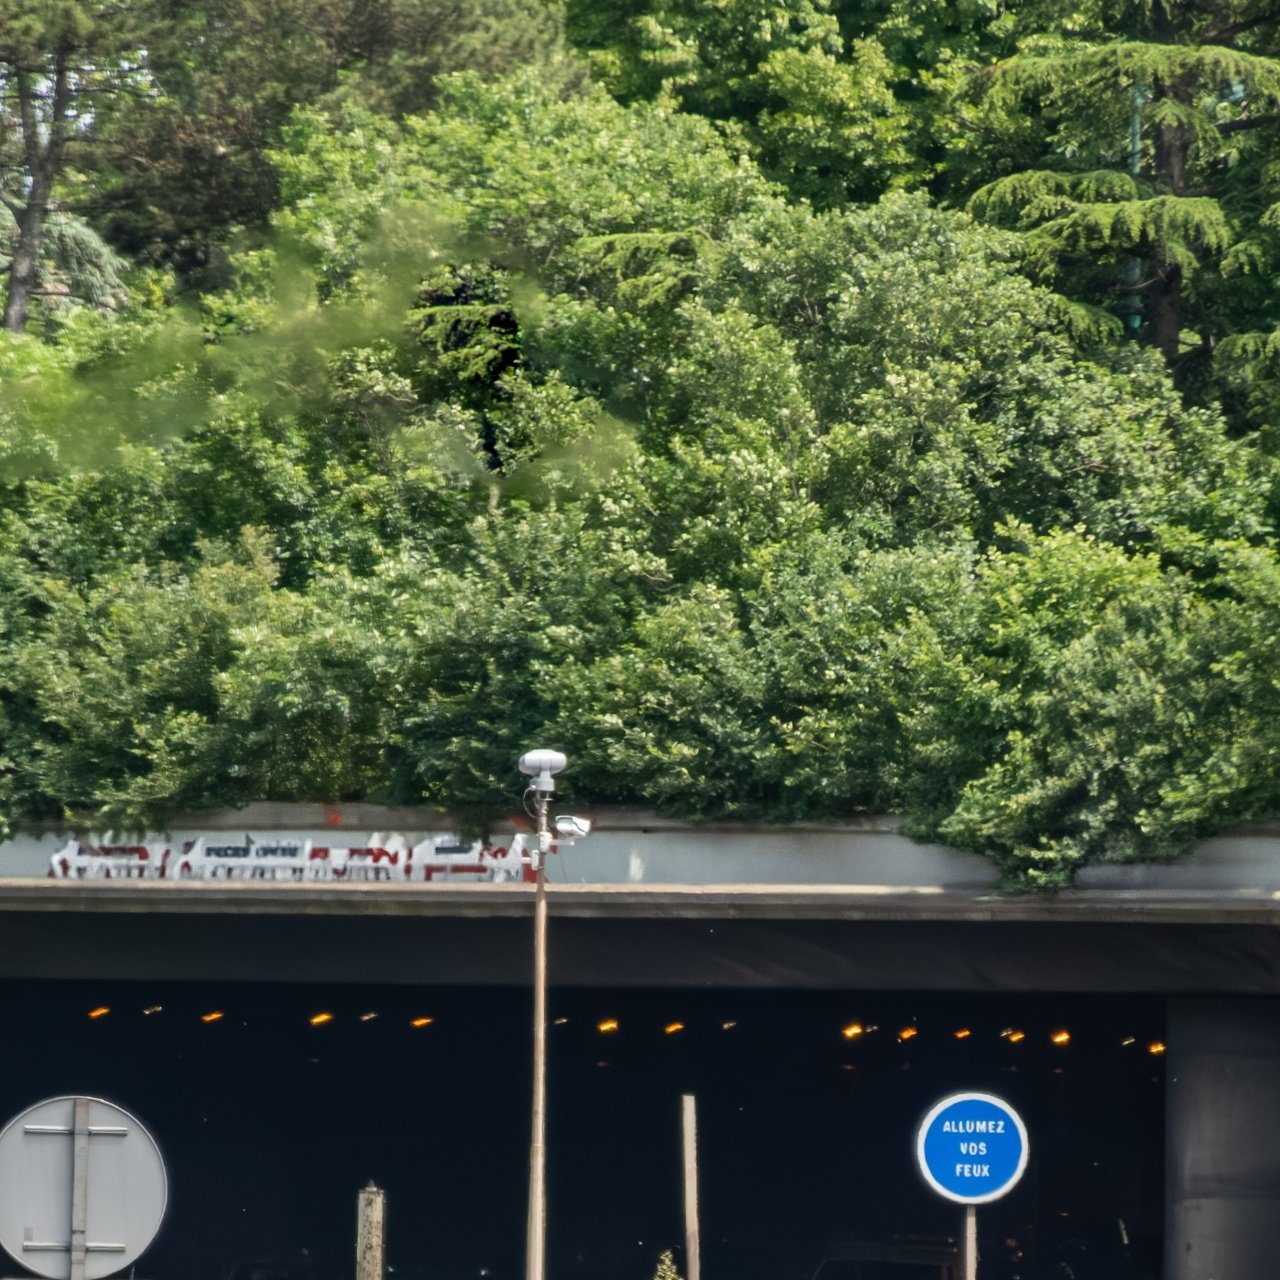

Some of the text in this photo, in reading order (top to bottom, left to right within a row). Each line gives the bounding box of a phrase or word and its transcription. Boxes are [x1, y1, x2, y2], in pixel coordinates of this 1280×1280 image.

[943, 1121, 1005, 1133] ALLUMEZ
[960, 1142, 987, 1155] VOS
[956, 1164, 990, 1177] FEUX
